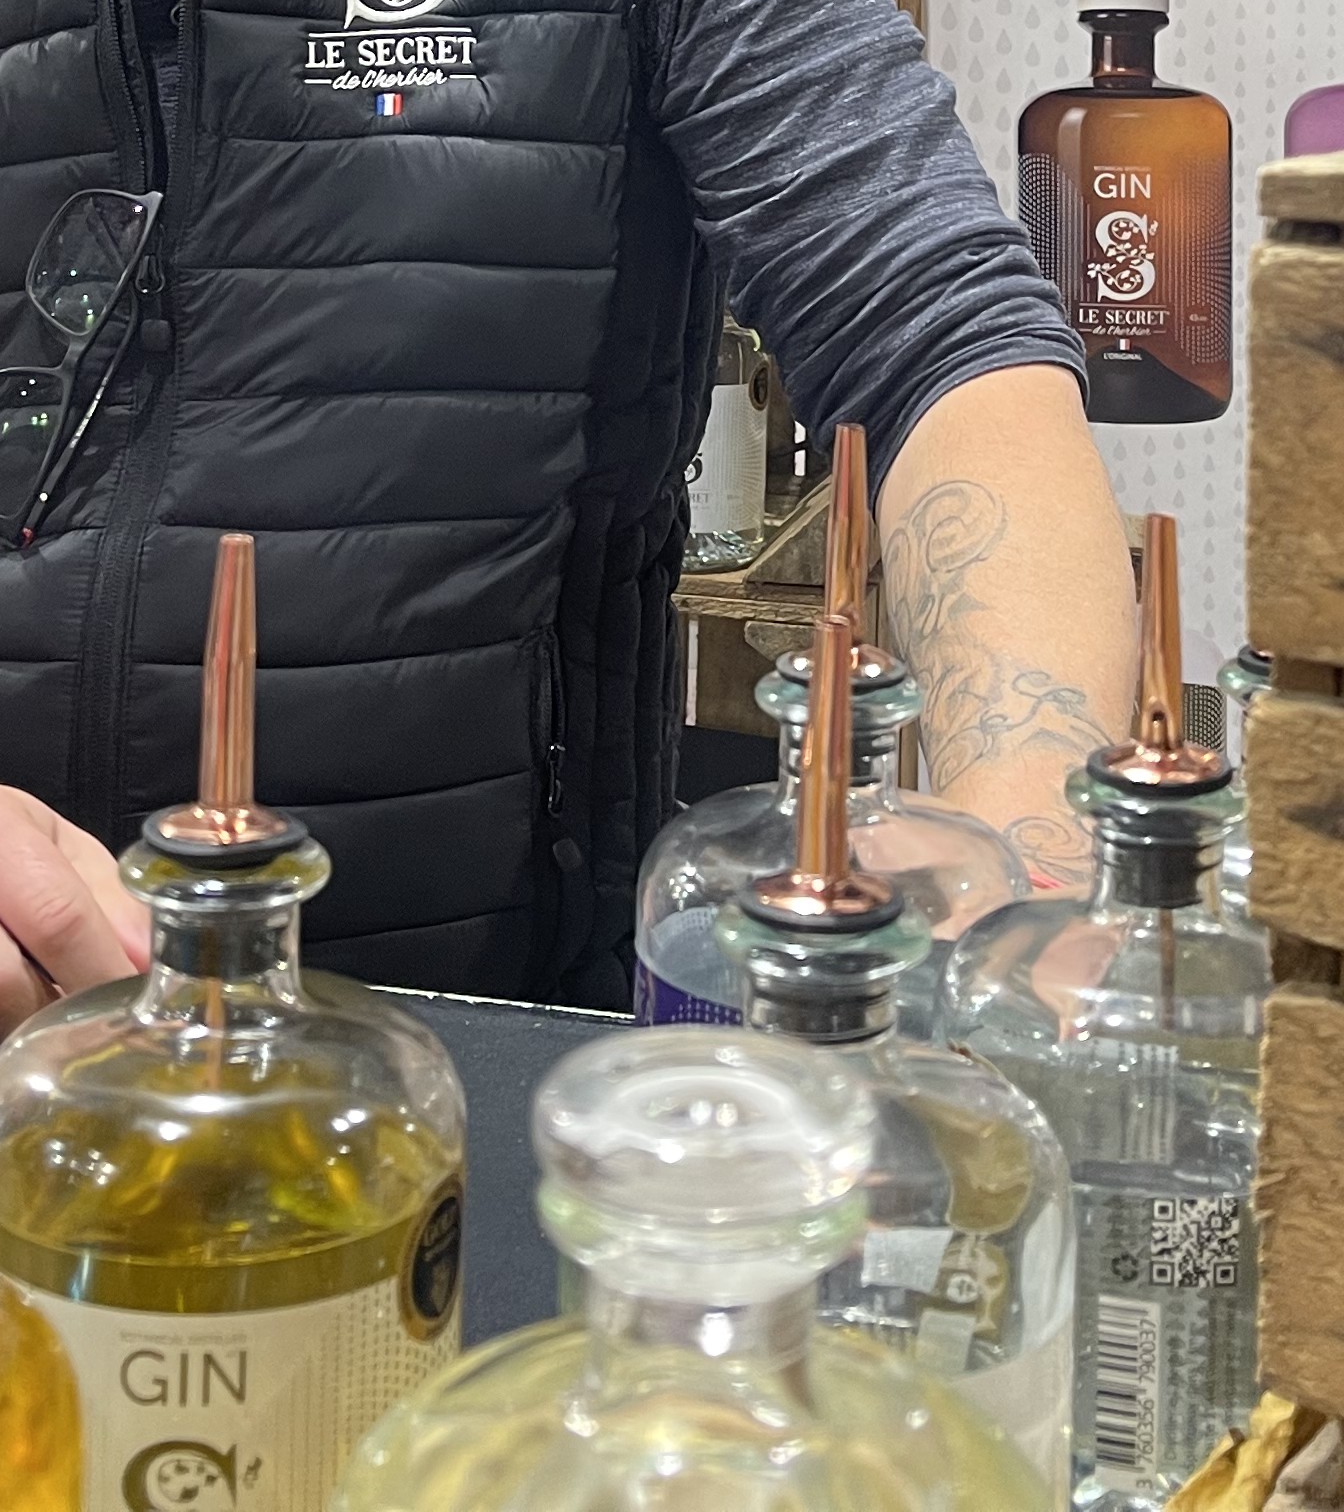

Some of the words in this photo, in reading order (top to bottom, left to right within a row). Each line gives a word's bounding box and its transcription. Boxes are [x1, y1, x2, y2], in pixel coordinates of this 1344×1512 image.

[305, 40, 346, 69] LE
[358, 36, 478, 67] SECRET
[1093, 173, 1151, 199] GIN
[1078, 308, 1100, 324] LE
[1105, 308, 1167, 326] SECRET
[119, 1349, 248, 1407] GIN
